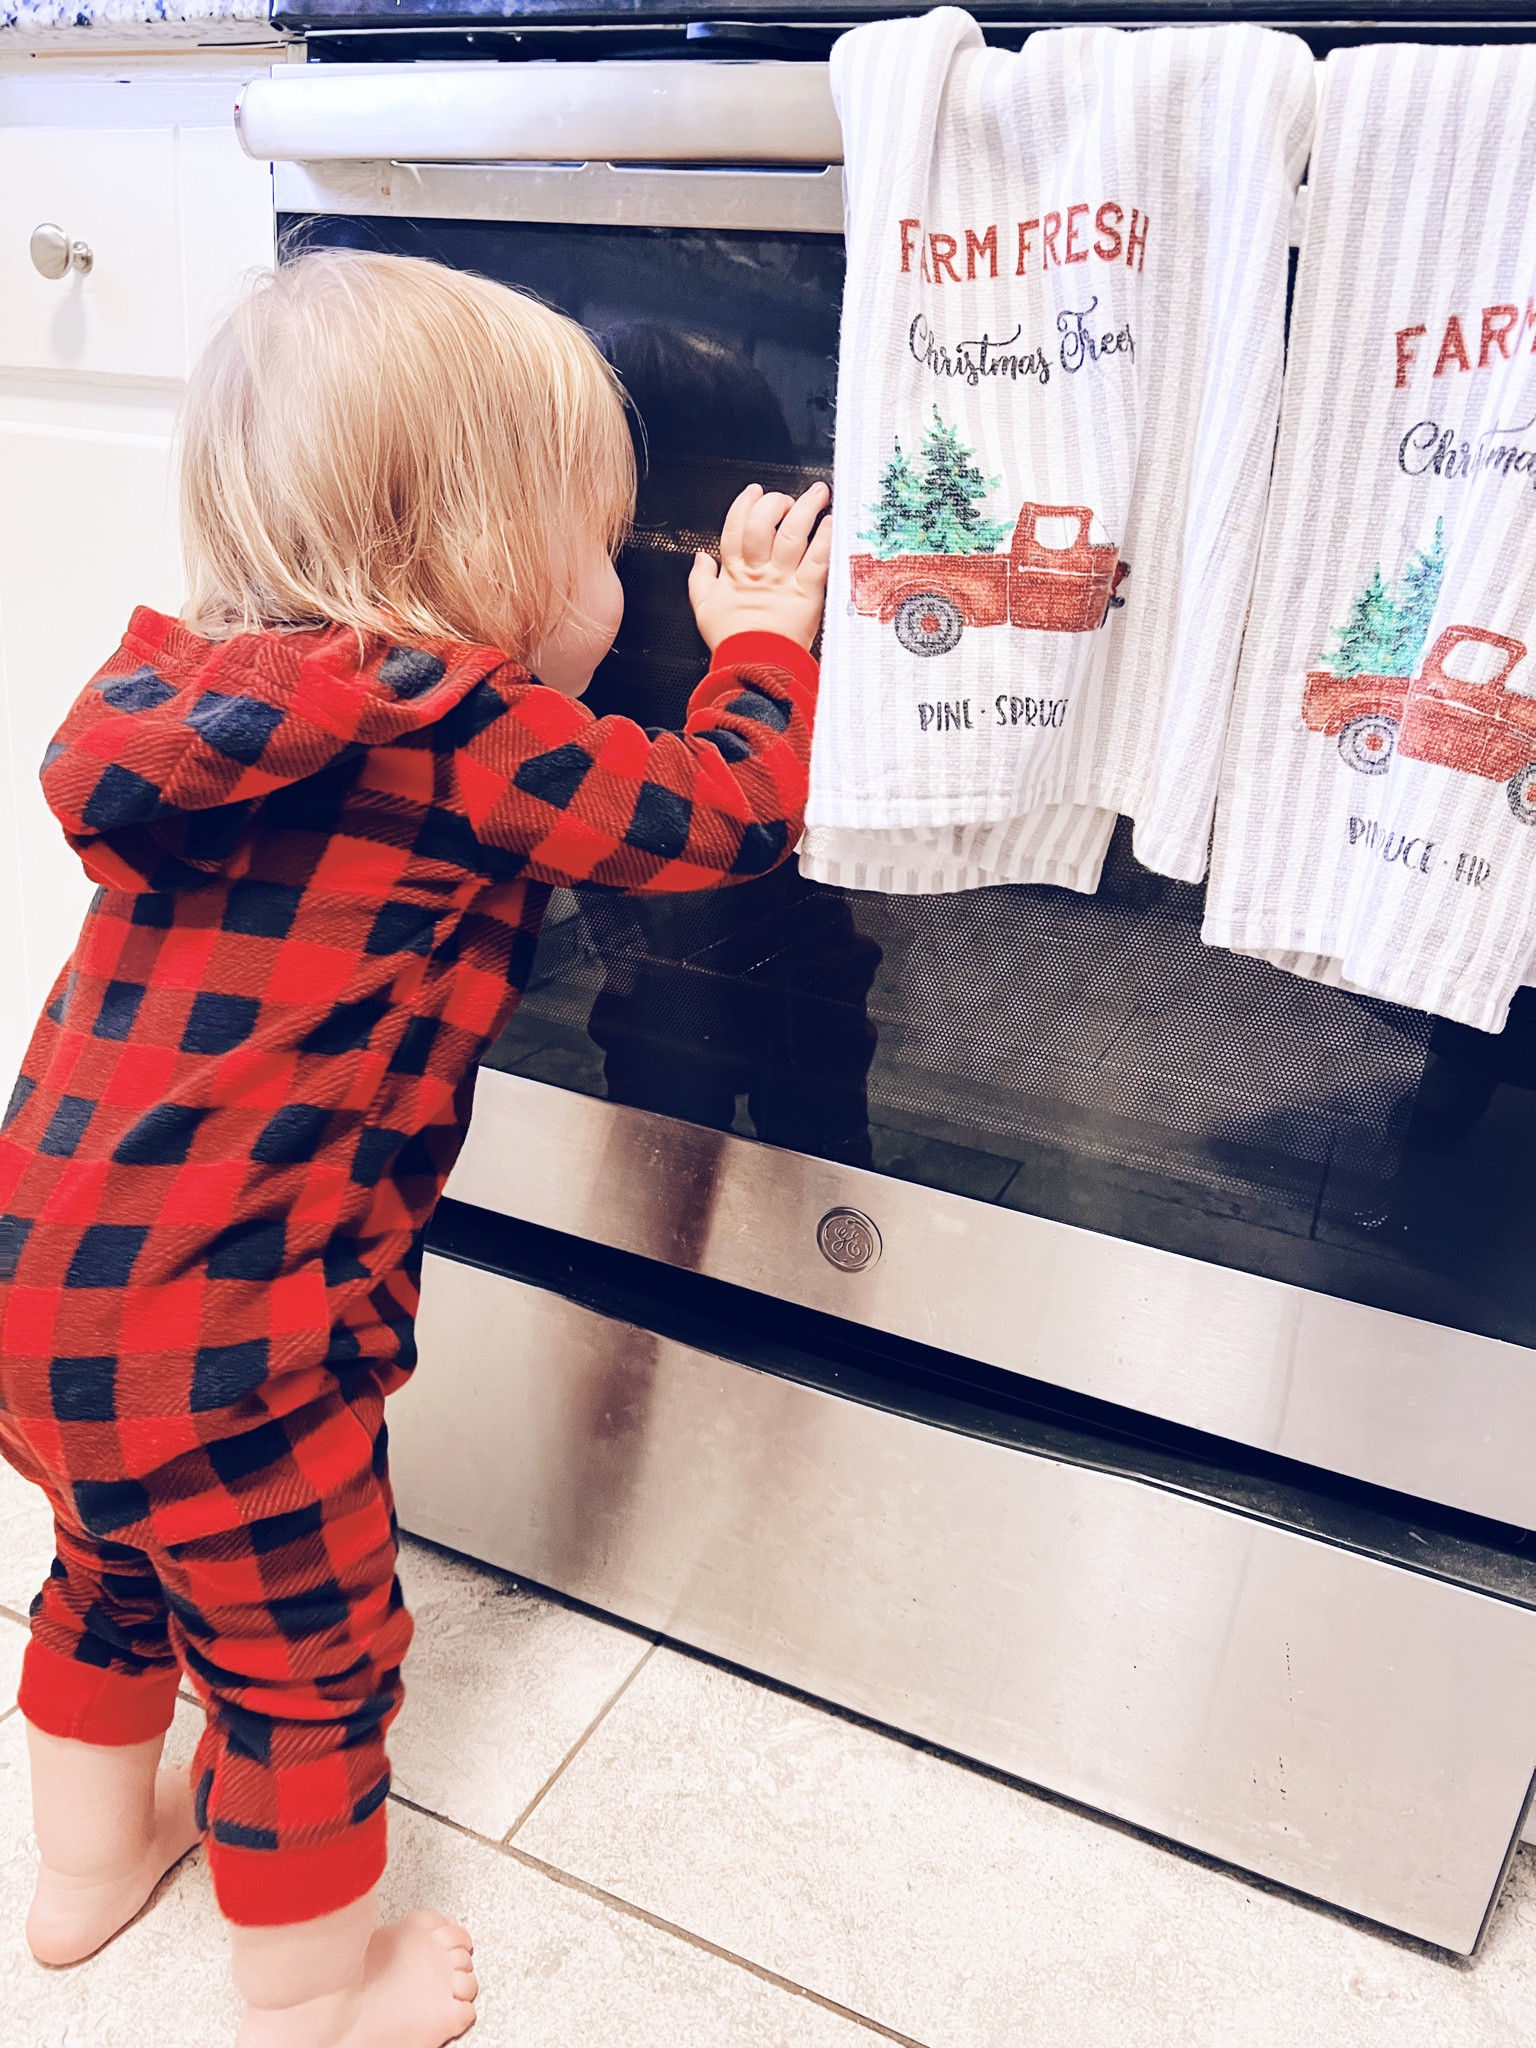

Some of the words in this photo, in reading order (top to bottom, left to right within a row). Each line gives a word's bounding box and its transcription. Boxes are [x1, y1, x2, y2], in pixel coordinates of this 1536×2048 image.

[1015, 201, 1150, 275] FRESH
[909, 313, 1054, 386] Christmas
[918, 699, 974, 732] PINE
